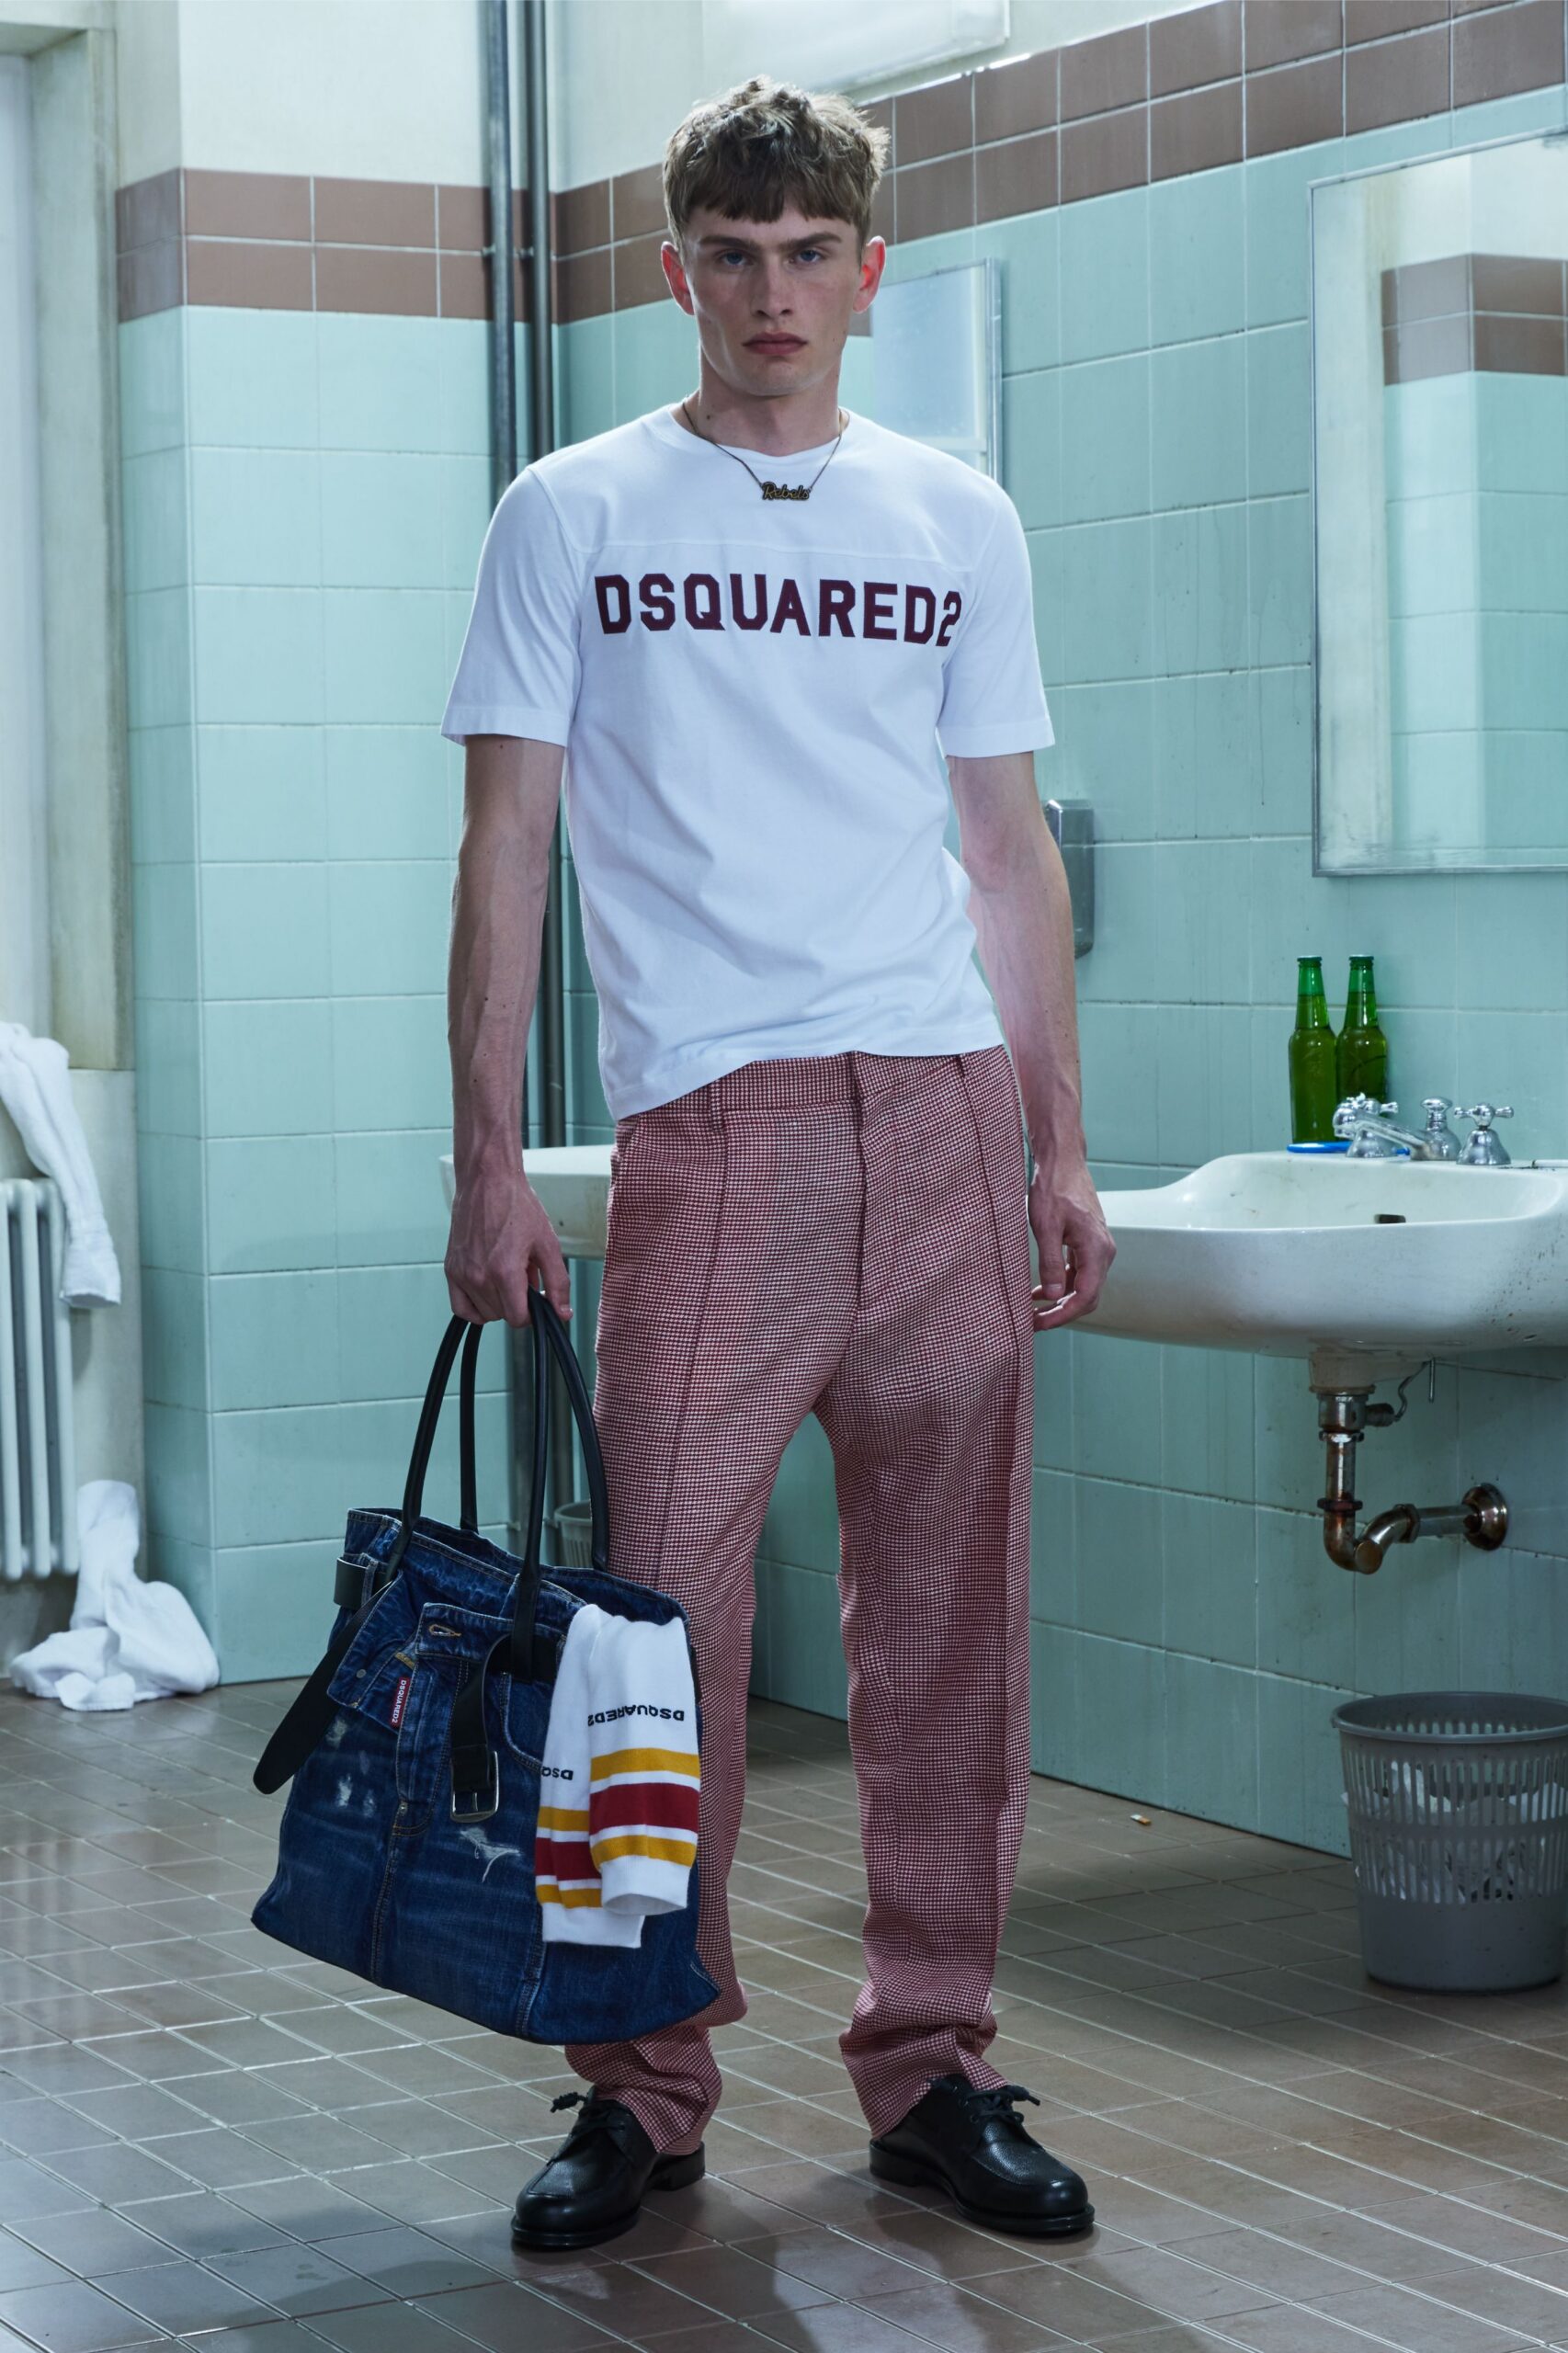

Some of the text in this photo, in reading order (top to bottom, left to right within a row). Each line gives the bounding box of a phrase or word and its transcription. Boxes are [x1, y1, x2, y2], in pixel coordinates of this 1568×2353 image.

[595, 573, 962, 647] DSQUARED2
[392, 1679, 407, 1723] DSQUARED2
[587, 1704, 685, 1726] DSQUARED2
